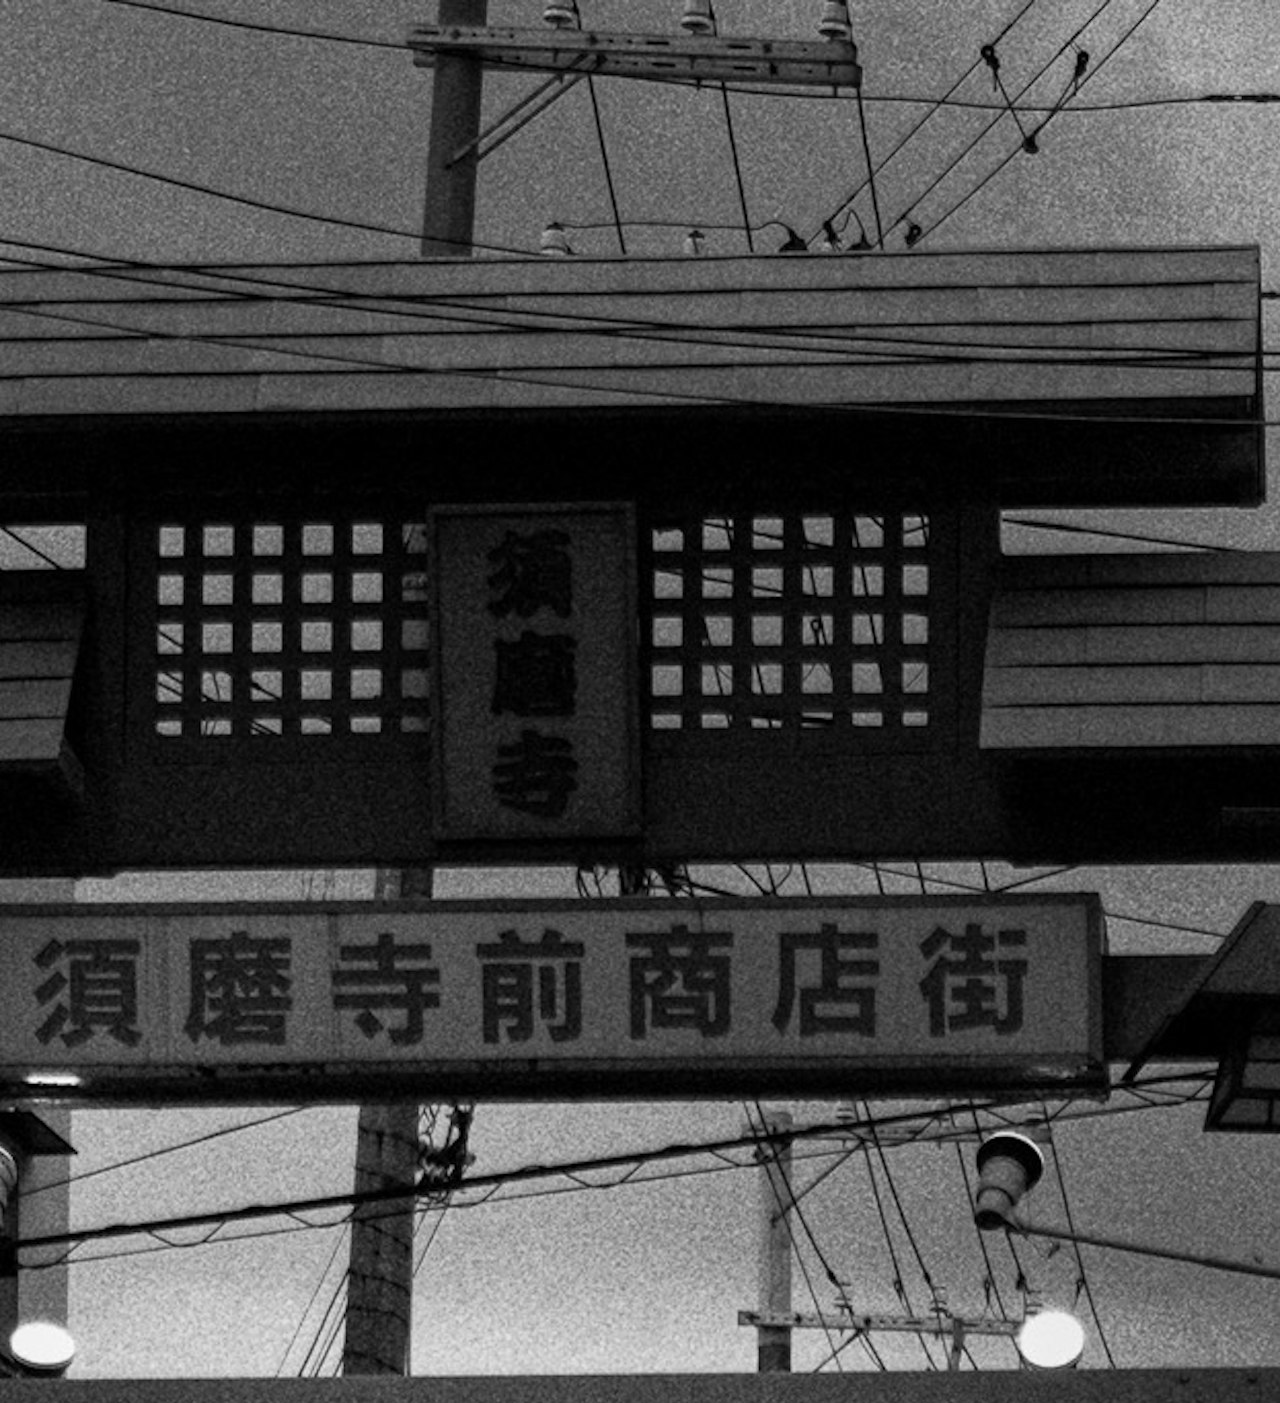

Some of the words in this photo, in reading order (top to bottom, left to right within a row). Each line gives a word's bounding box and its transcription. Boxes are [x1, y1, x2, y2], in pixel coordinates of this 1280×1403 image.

[32, 923, 1027, 1048] 須磨寺前商店街
